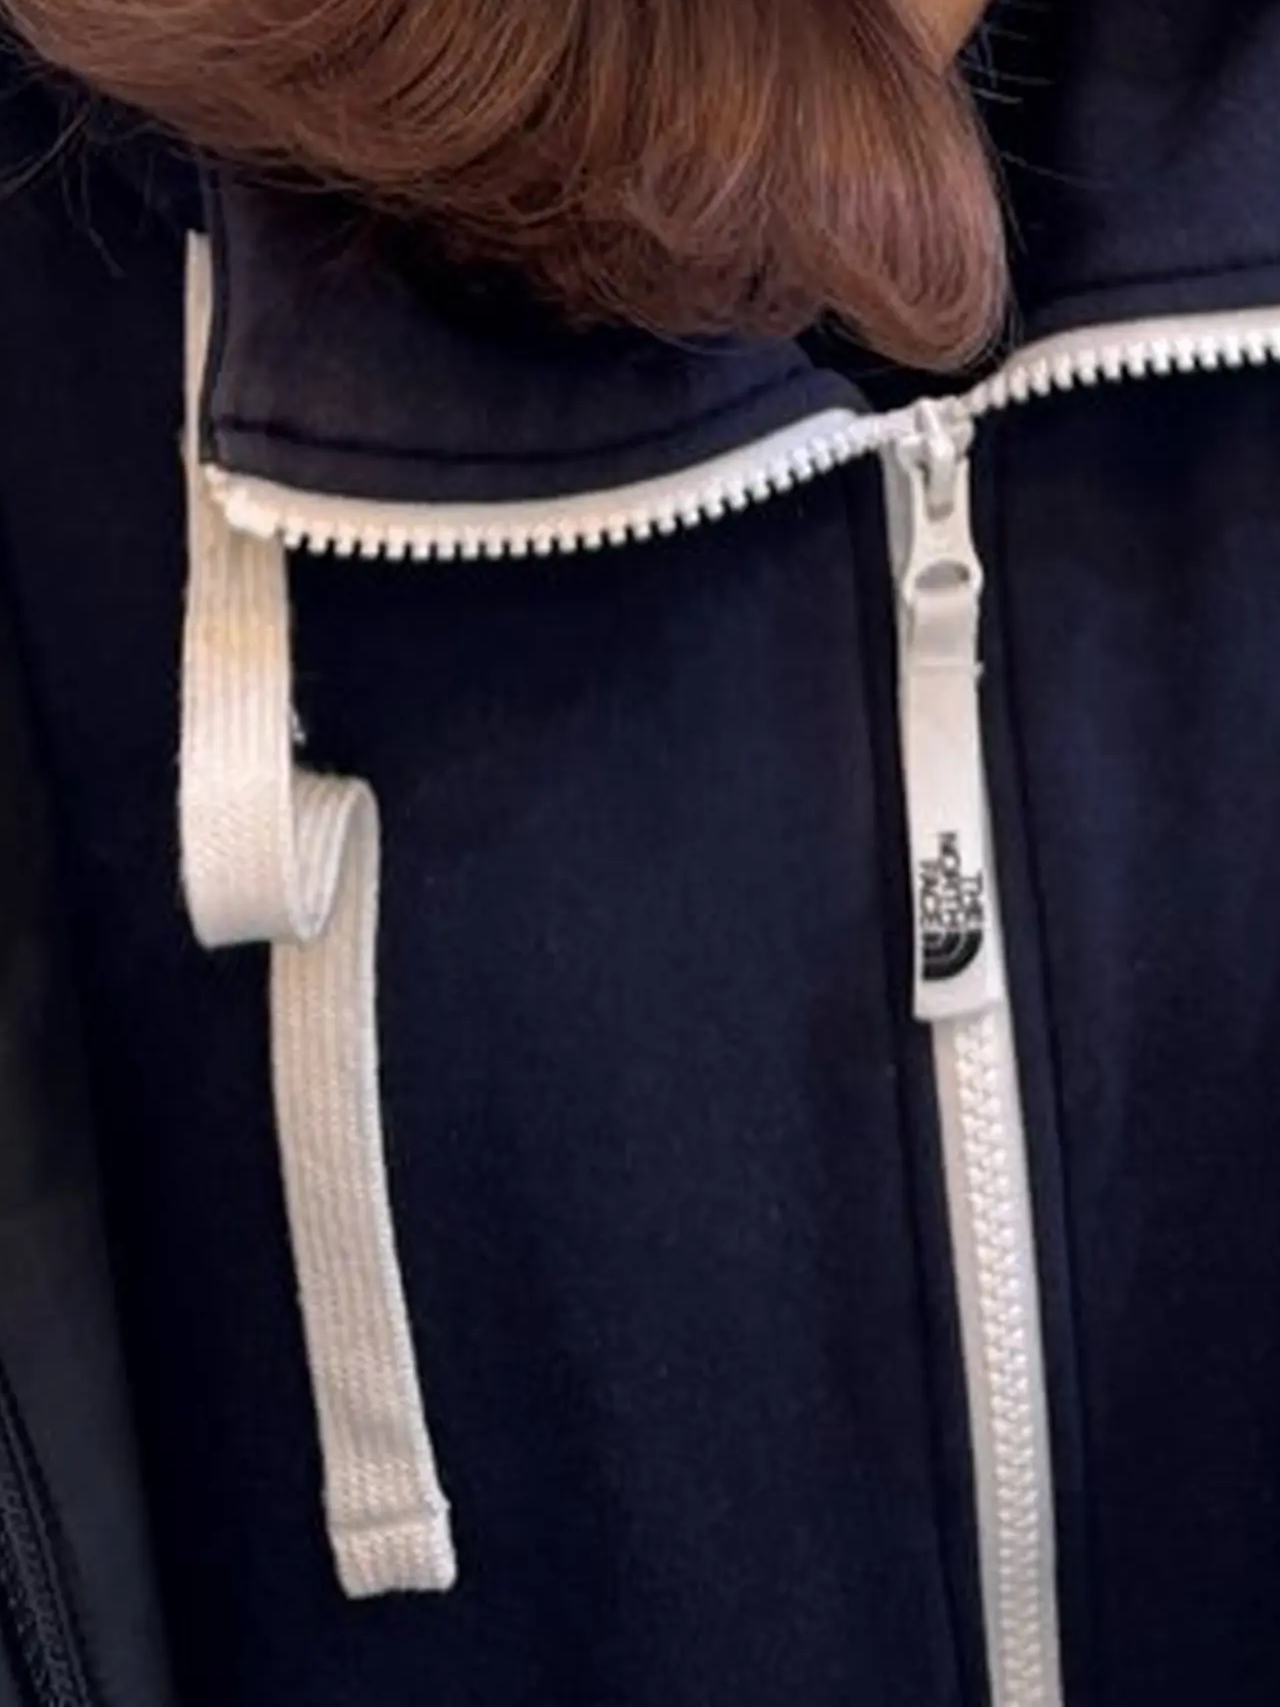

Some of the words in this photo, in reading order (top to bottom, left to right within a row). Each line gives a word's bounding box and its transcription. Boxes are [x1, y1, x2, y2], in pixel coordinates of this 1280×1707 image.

[920, 860, 940, 927] FACE
[939, 832, 964, 928] NORTH
[960, 870, 984, 924] THE
